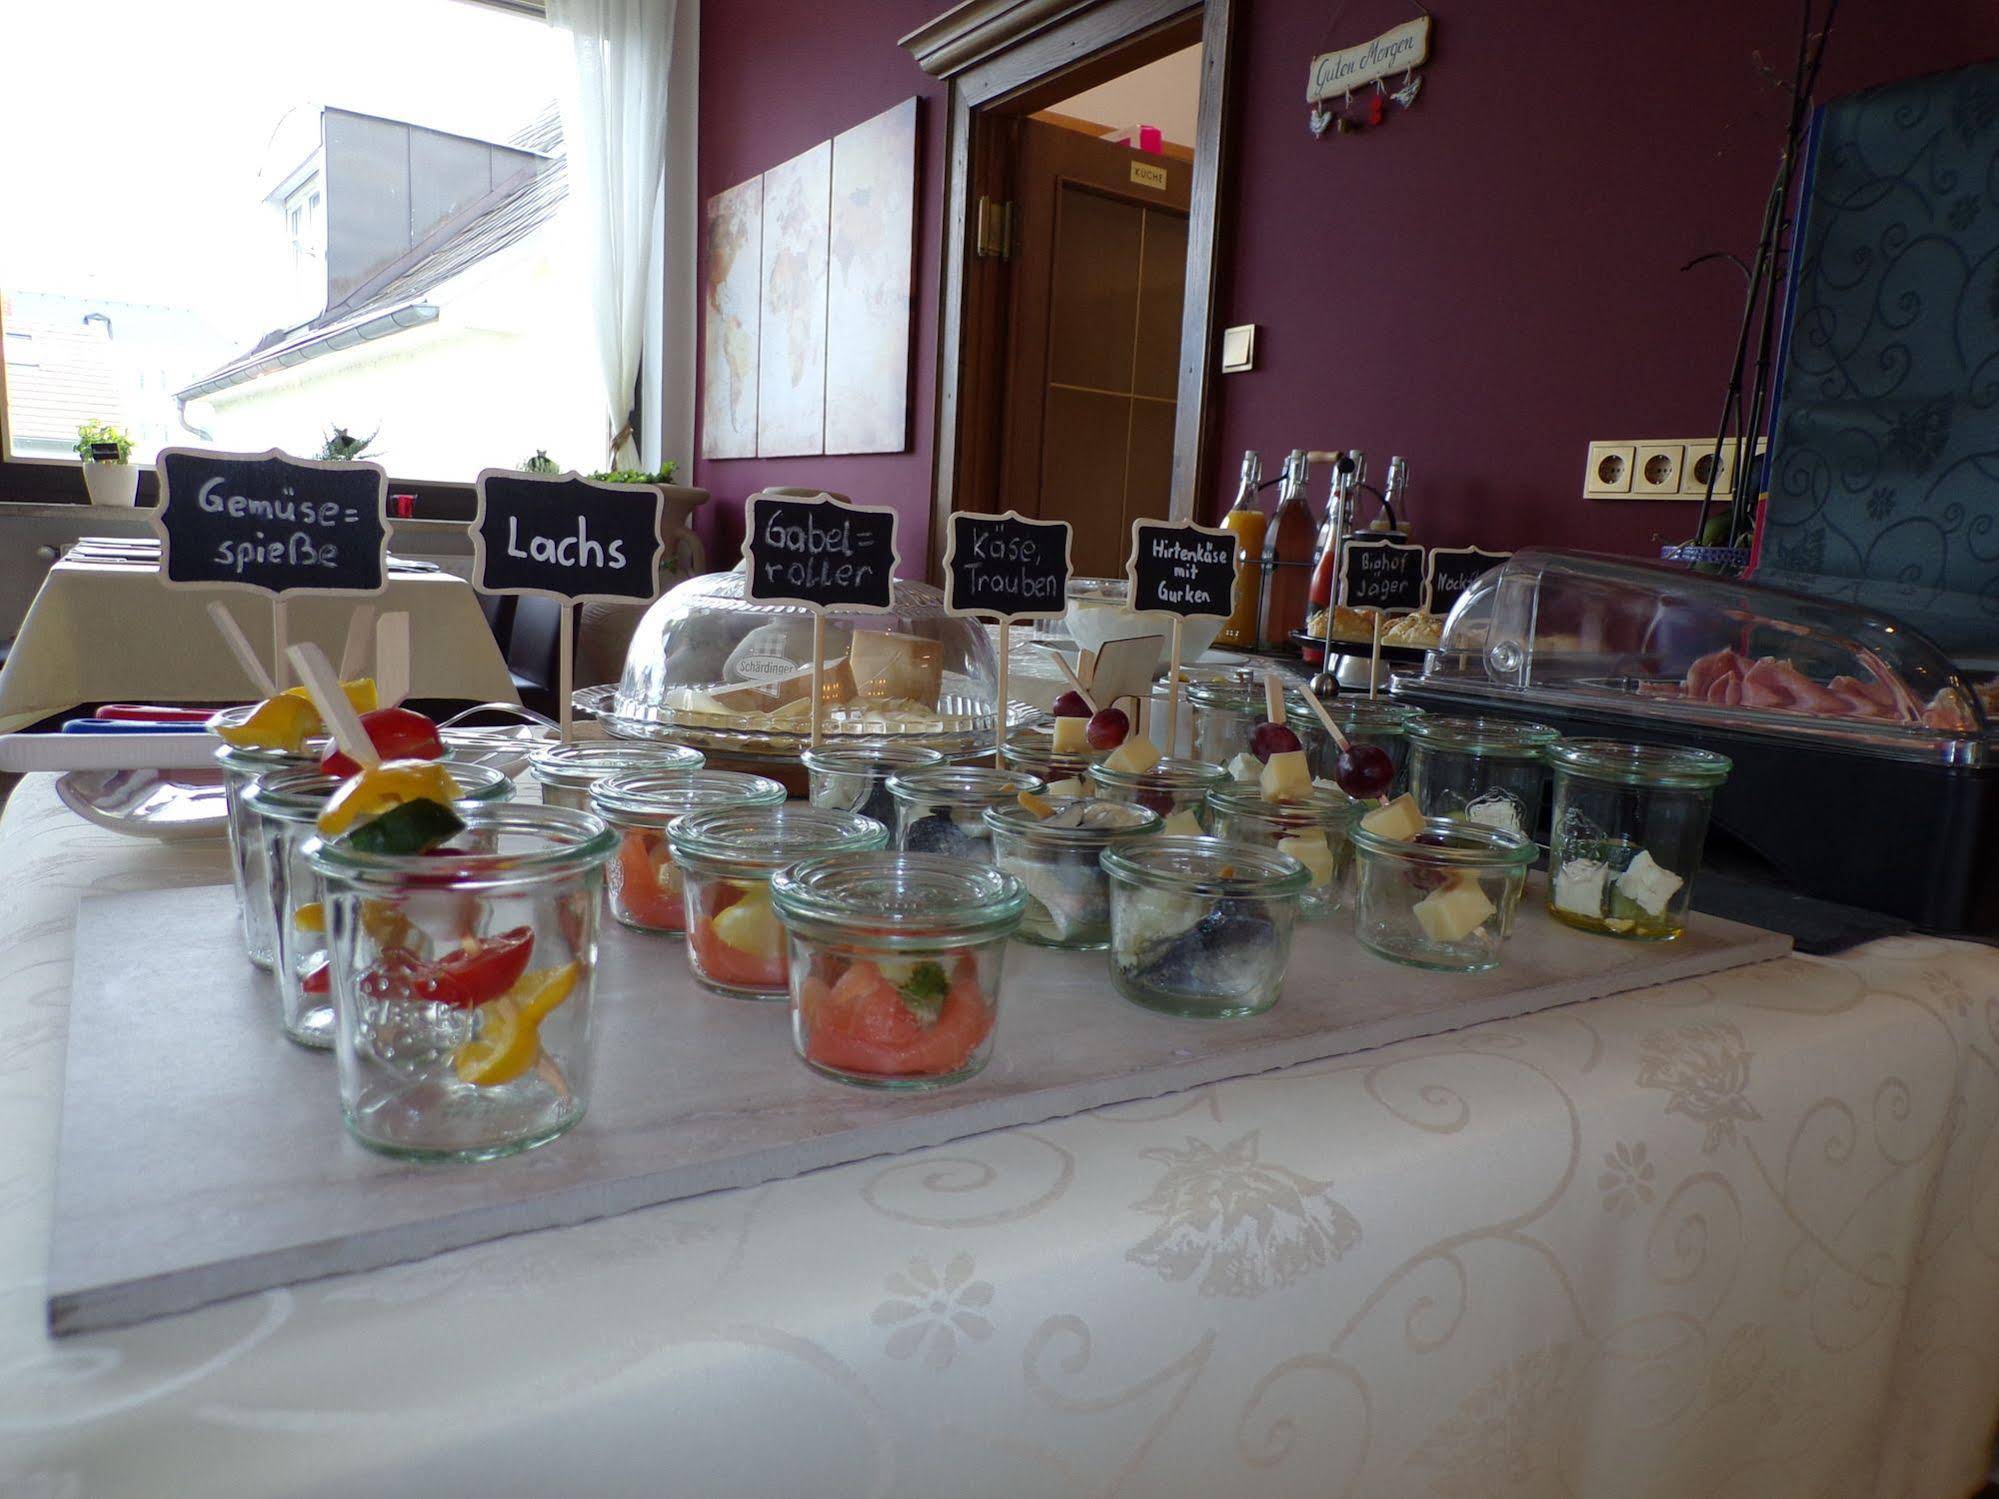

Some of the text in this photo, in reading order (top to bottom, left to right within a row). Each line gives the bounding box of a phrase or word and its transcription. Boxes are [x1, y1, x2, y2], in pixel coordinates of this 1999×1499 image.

[1316, 36, 1415, 89] Guten Morgen
[1134, 167, 1163, 184] KÜCHE
[213, 531, 339, 574] spieße
[507, 515, 627, 570] Lachs
[972, 523, 1041, 566] Käse,
[1152, 538, 1228, 564] Hirtenkäse
[764, 556, 874, 588] roller
[1173, 563, 1199, 580] mit
[1361, 551, 1409, 574] Biohof
[963, 562, 1057, 598] Trauben
[1157, 580, 1211, 603] Gurken
[1356, 572, 1409, 601] Jäger
[739, 660, 794, 675] Schärdinger
